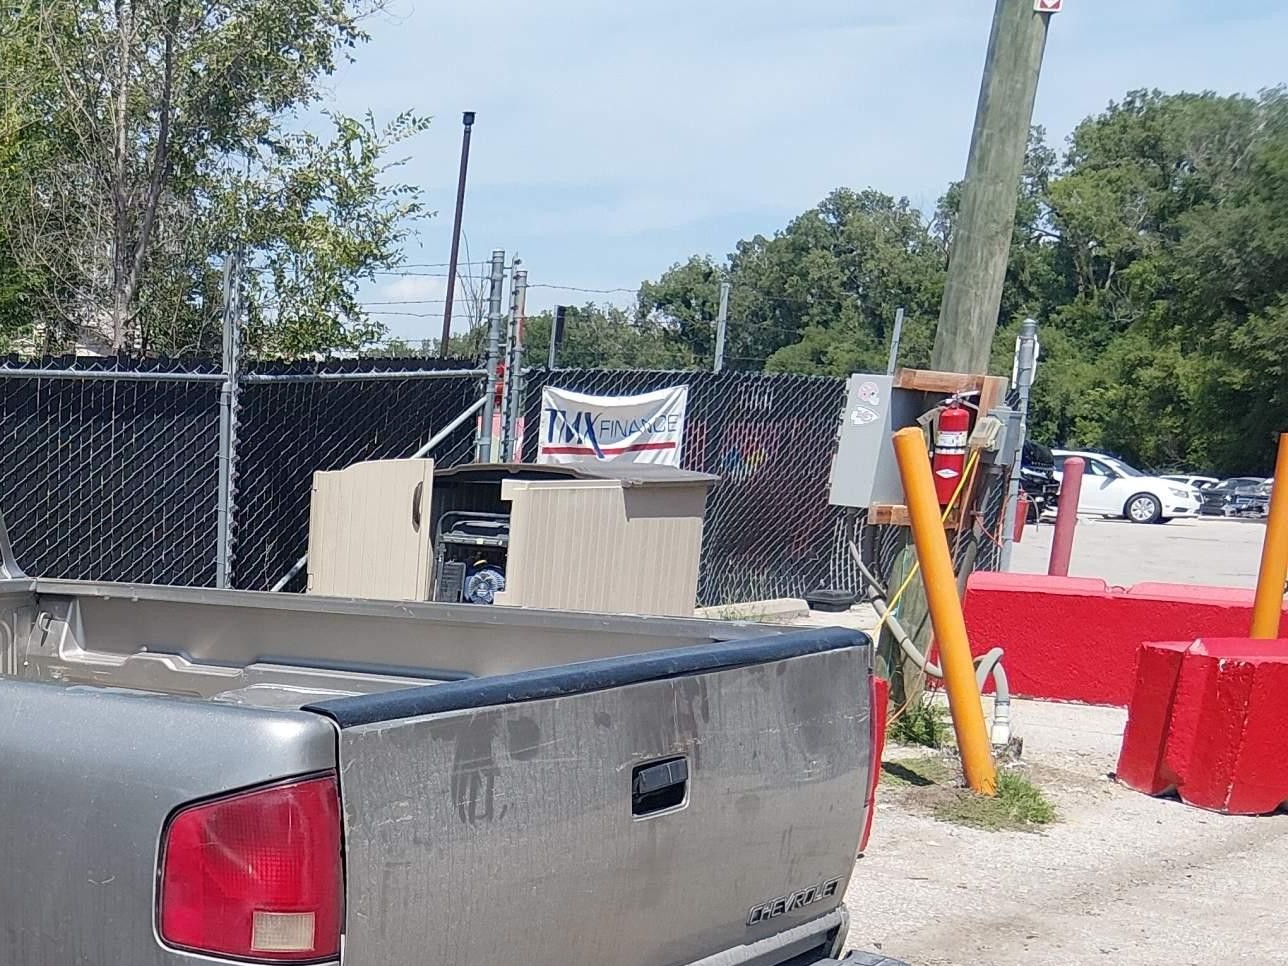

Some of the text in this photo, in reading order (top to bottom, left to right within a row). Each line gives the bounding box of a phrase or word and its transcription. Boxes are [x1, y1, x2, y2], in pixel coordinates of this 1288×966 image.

[545, 408, 680, 459] TMX FINANCE
[746, 875, 844, 926] CHEVROLET
